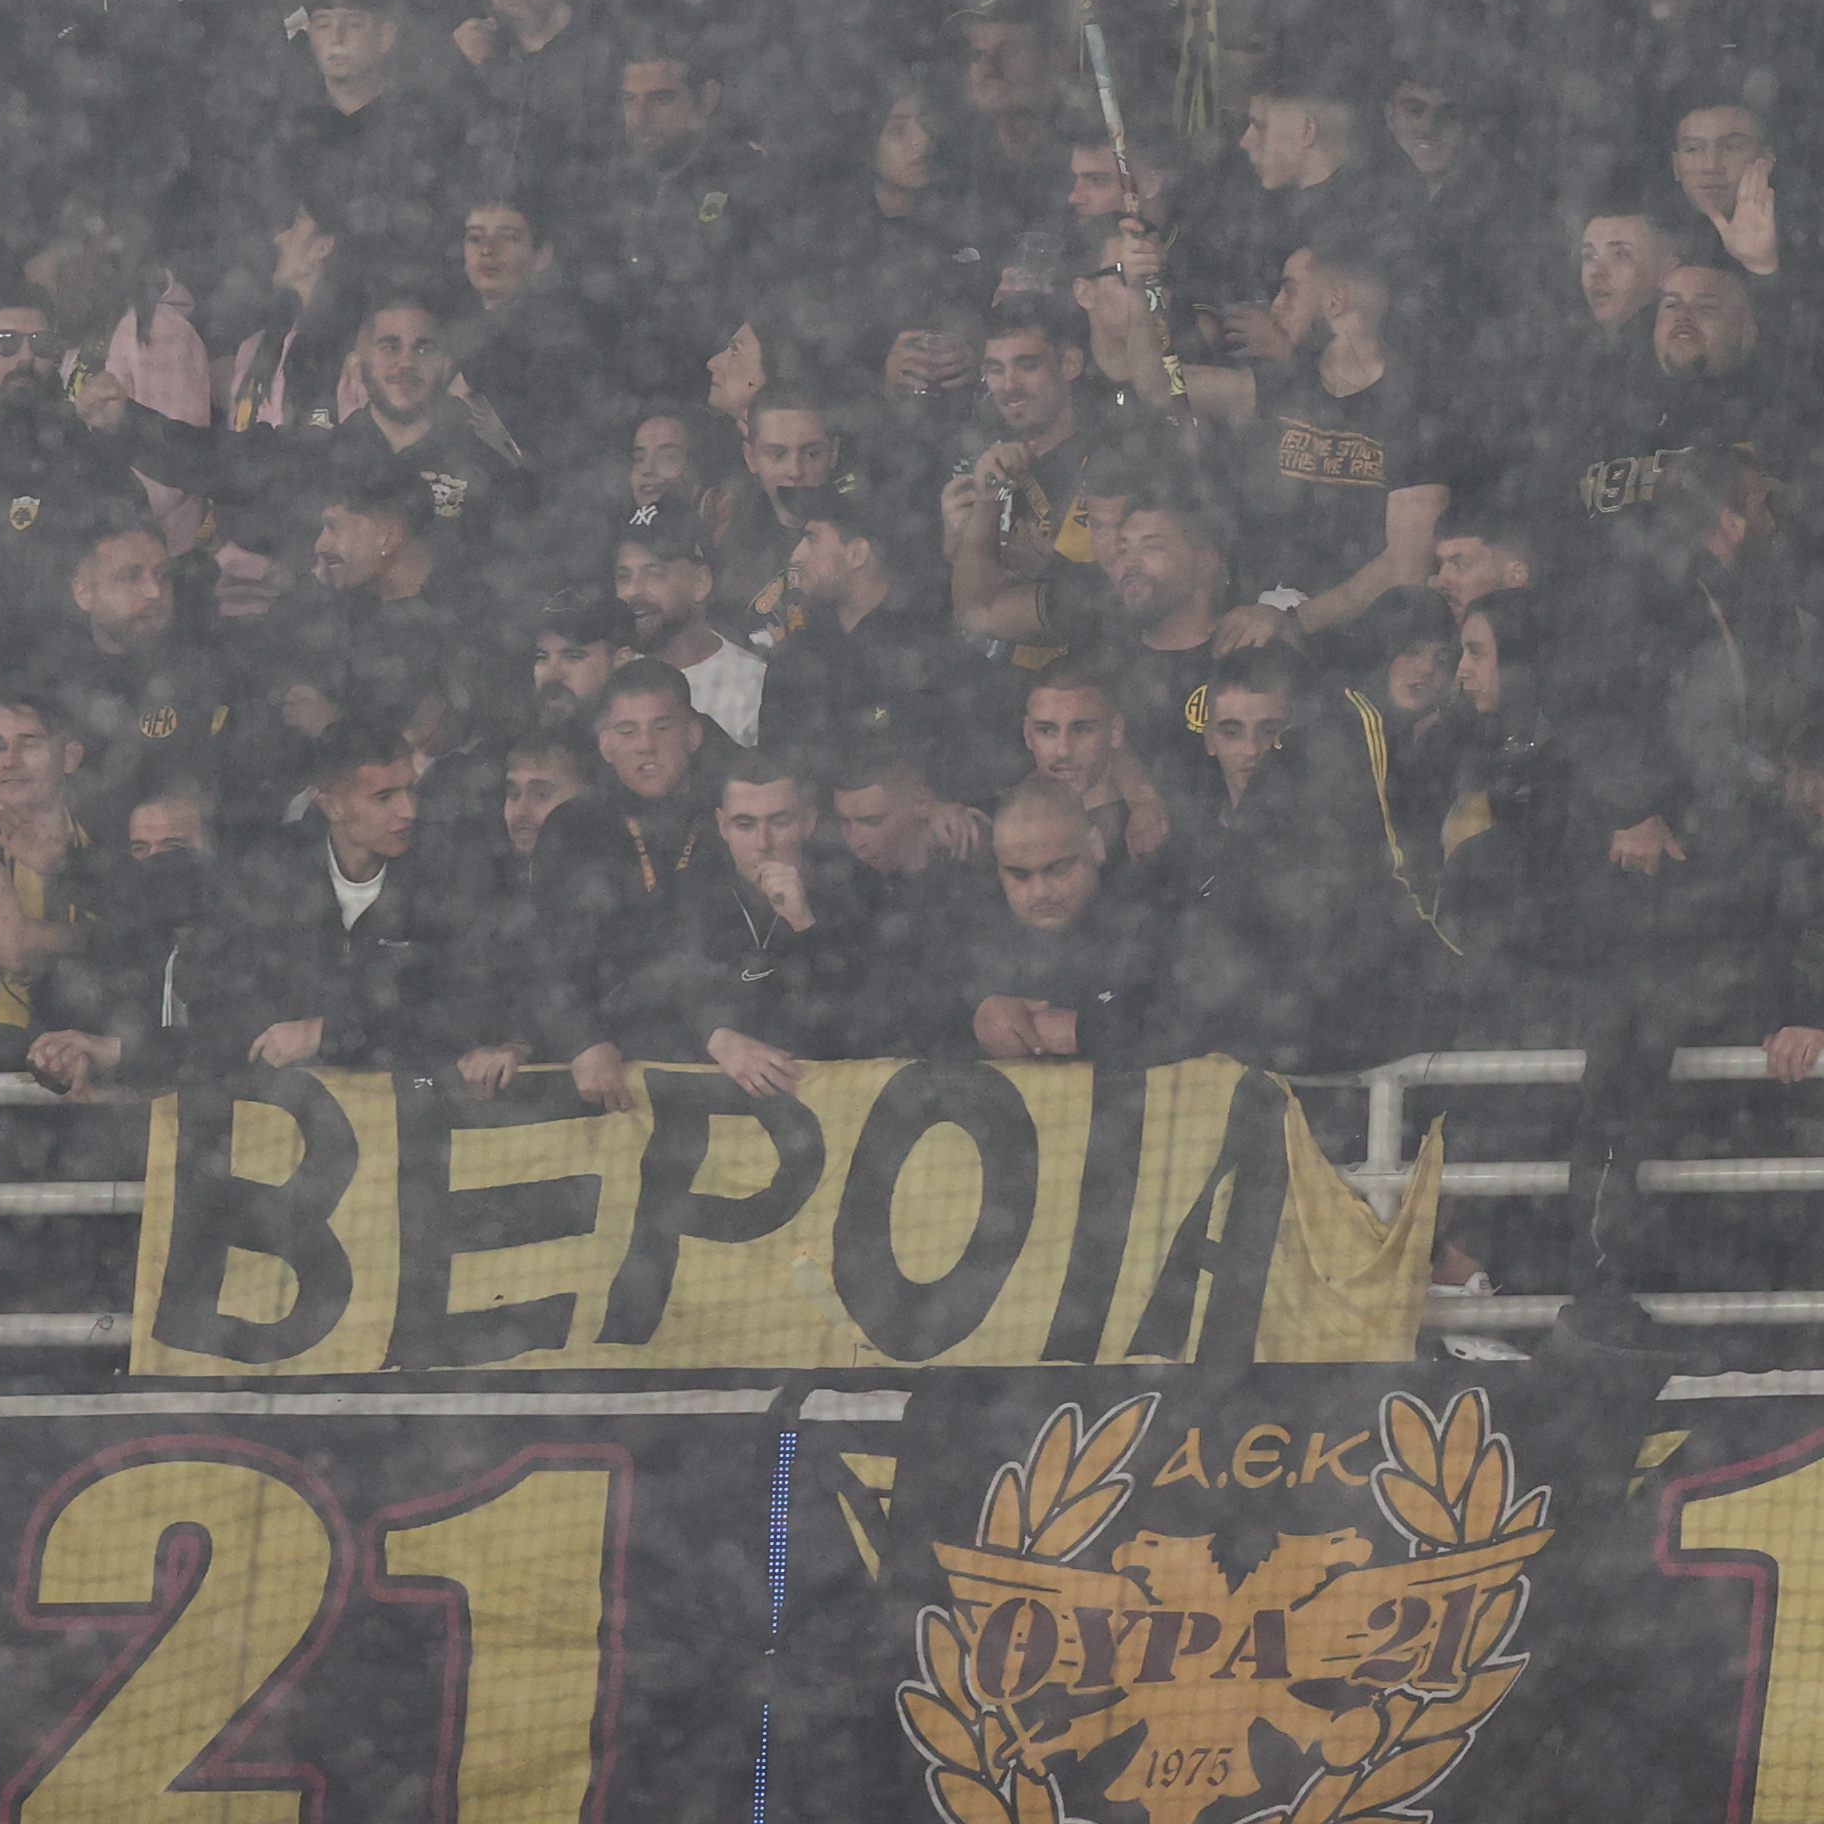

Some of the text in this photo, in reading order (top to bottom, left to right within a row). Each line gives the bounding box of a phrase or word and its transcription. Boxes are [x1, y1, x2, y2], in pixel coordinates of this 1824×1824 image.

[629, 505, 658, 526] NY
[151, 1060, 1286, 1370] ΒΕΡΟΙΑ
[4, 1434, 632, 1824] 21
[973, 1583, 1479, 1699] ΘΥΡΑ 21
[1143, 1747, 1236, 1790] 1975
